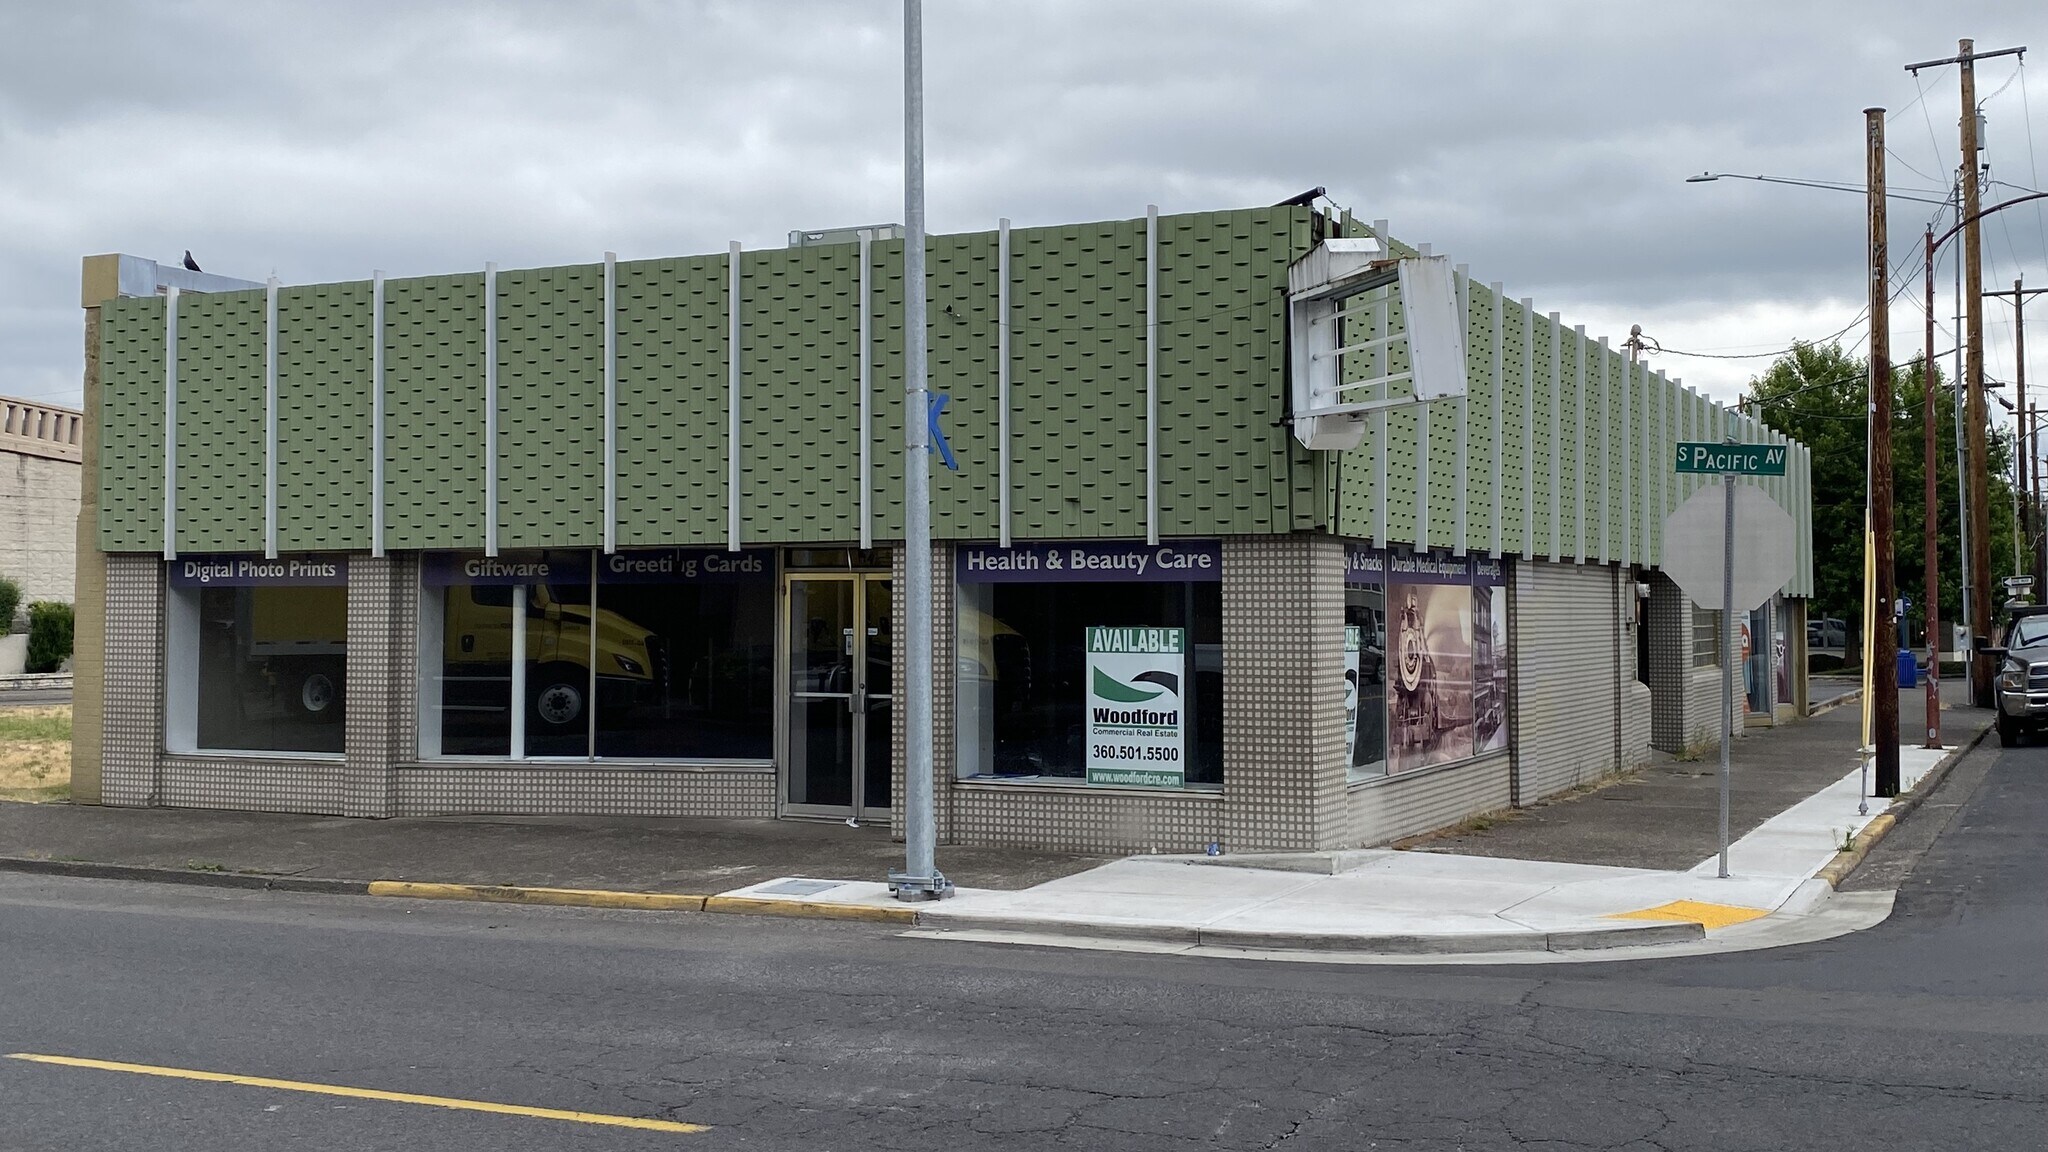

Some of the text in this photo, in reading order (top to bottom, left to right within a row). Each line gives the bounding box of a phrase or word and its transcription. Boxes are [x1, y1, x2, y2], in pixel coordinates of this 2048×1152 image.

[1678, 446, 1784, 470] S PACIFIC AV
[184, 560, 336, 582] Digital Photo Prints
[464, 558, 549, 578] Giftware
[703, 554, 763, 573] Cards
[967, 549, 1212, 575] Health & Beauty Care
[1353, 552, 1359, 570] &
[1360, 552, 1383, 571] Snacks
[1391, 555, 1467, 579] Durable Medical Equipment
[1092, 629, 1179, 653] AVAILABLE
[1093, 708, 1178, 726] Woodford
[1092, 727, 1178, 738] Commercial Real Estate
[1092, 745, 1179, 762] 360.501.5500
[1092, 771, 1180, 786] www.woodfordcre.com
